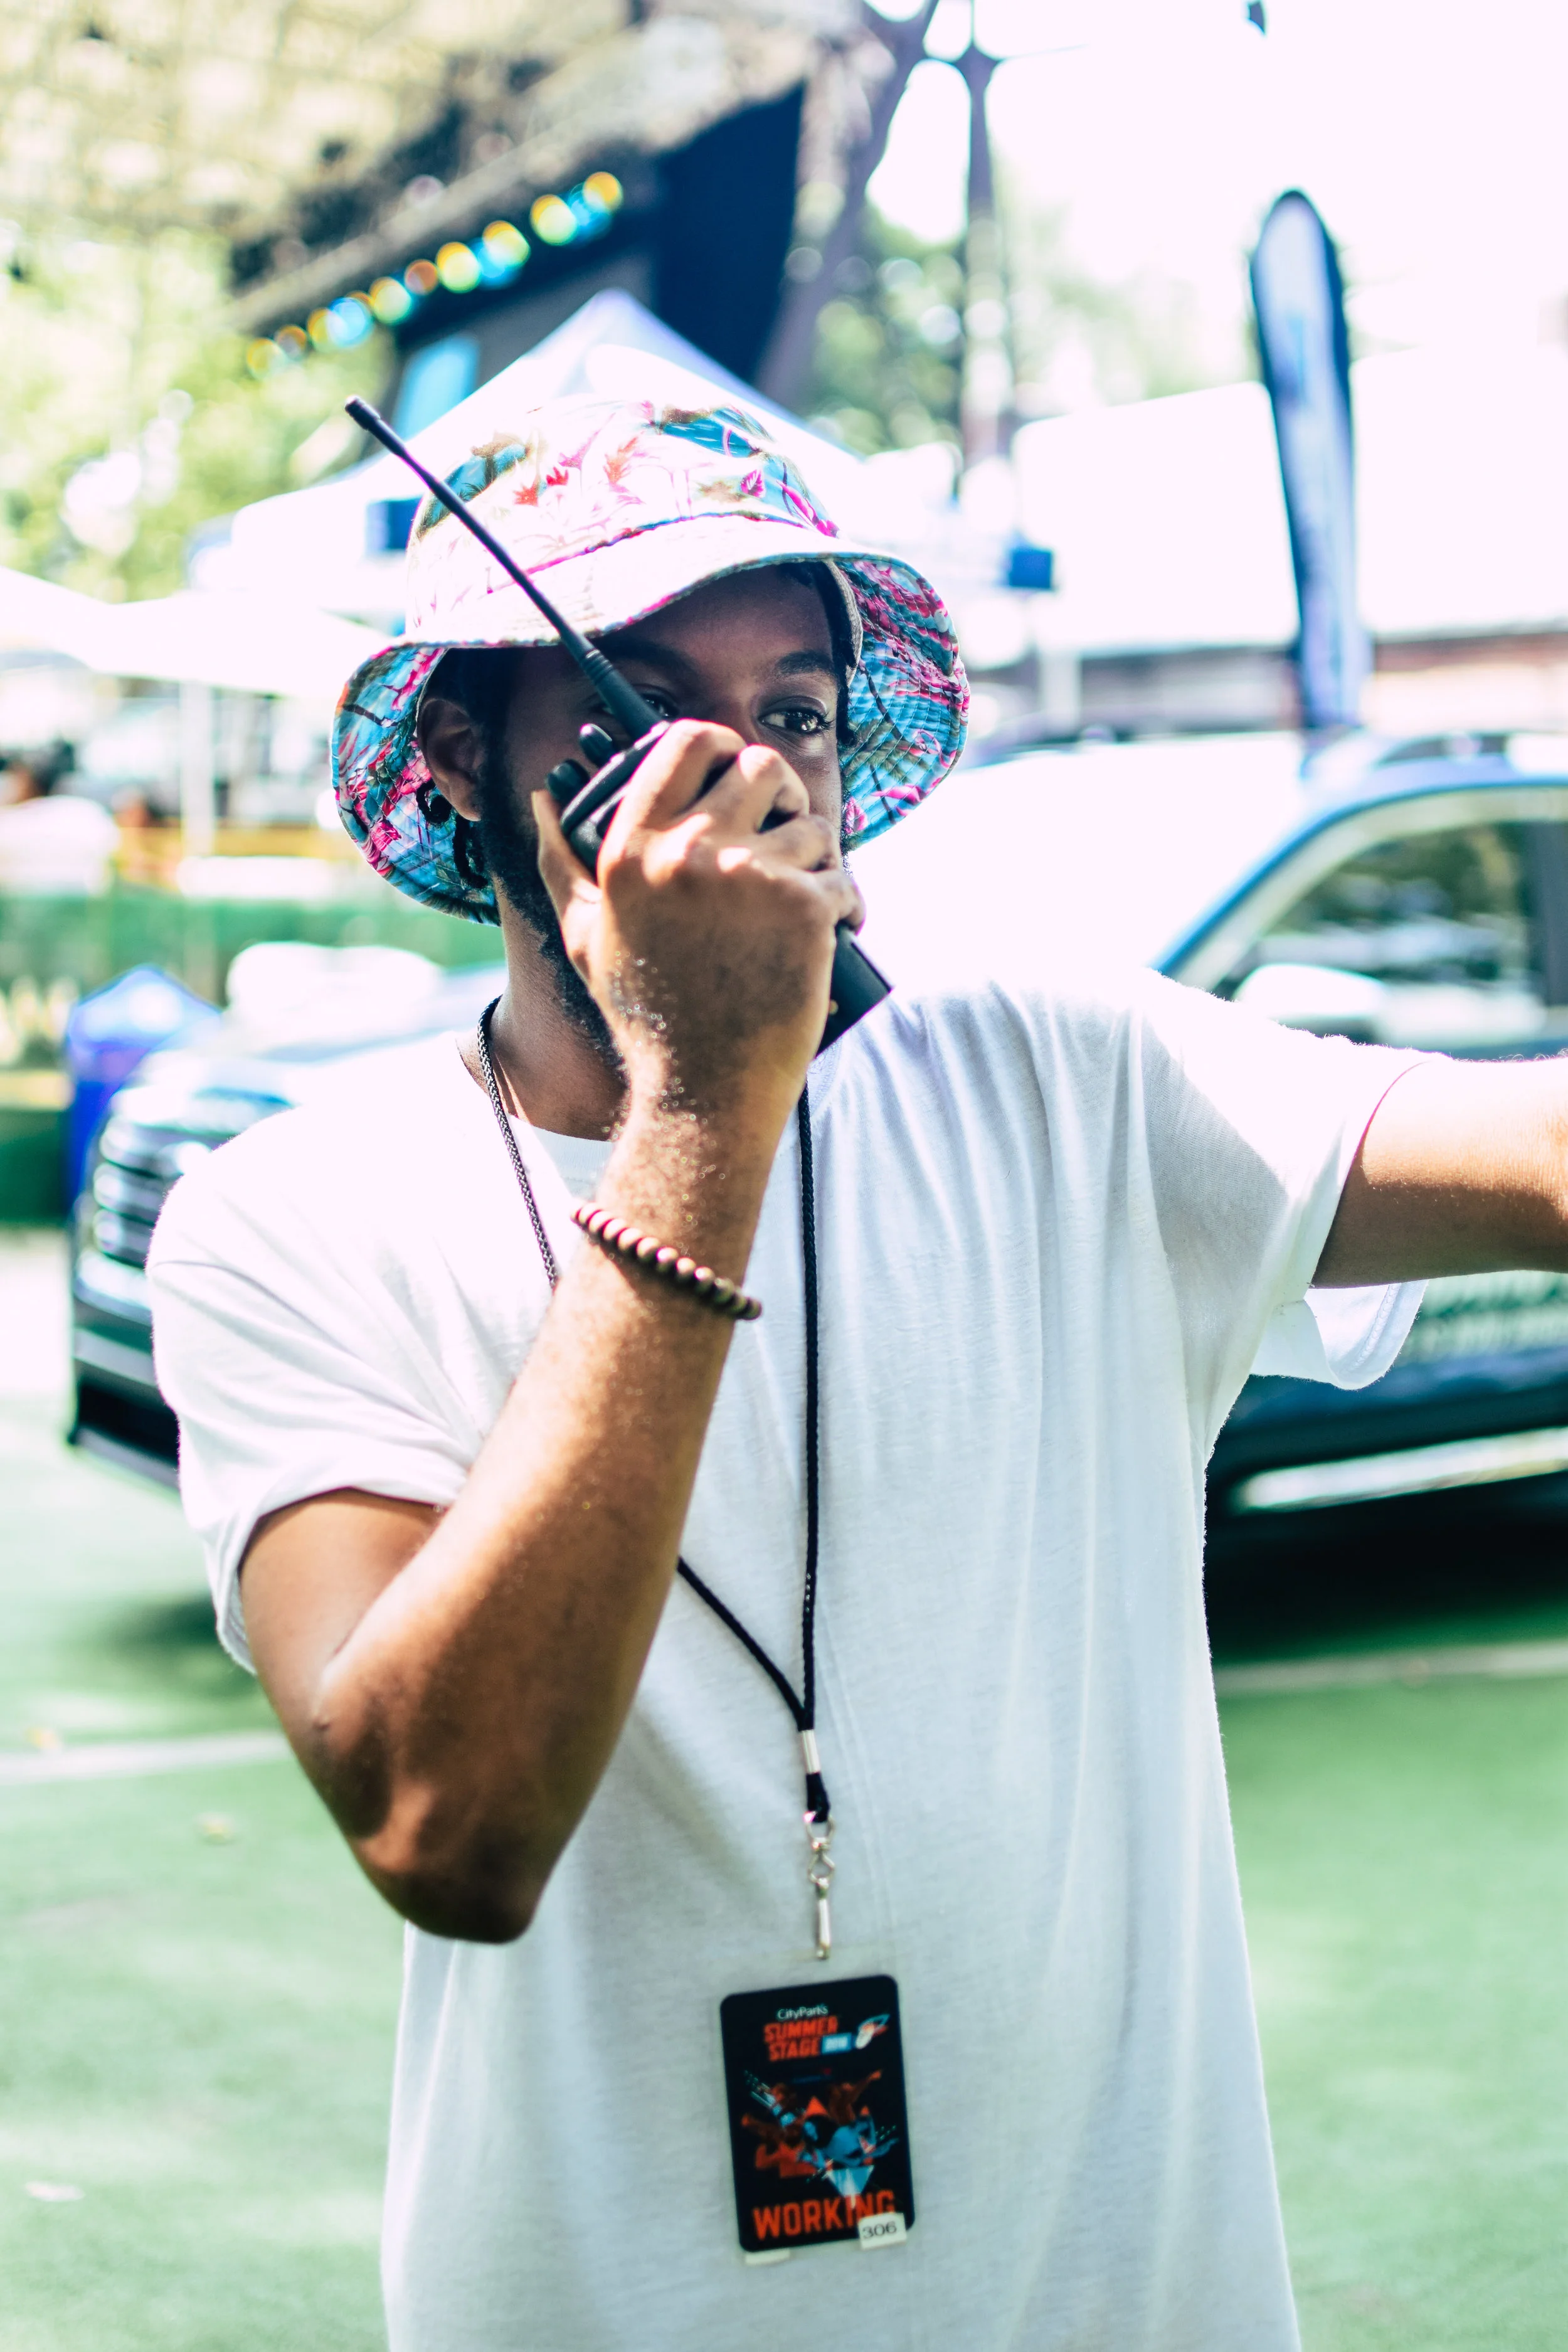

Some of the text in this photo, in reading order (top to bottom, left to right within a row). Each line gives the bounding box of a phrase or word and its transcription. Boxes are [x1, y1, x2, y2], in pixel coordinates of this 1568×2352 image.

[777, 2005, 828, 2020] CityParks
[764, 2016, 837, 2043] SUMMER
[769, 2038, 820, 2061] STAGE
[754, 2190, 895, 2240] WORKING
[862, 2221, 897, 2240] 306
